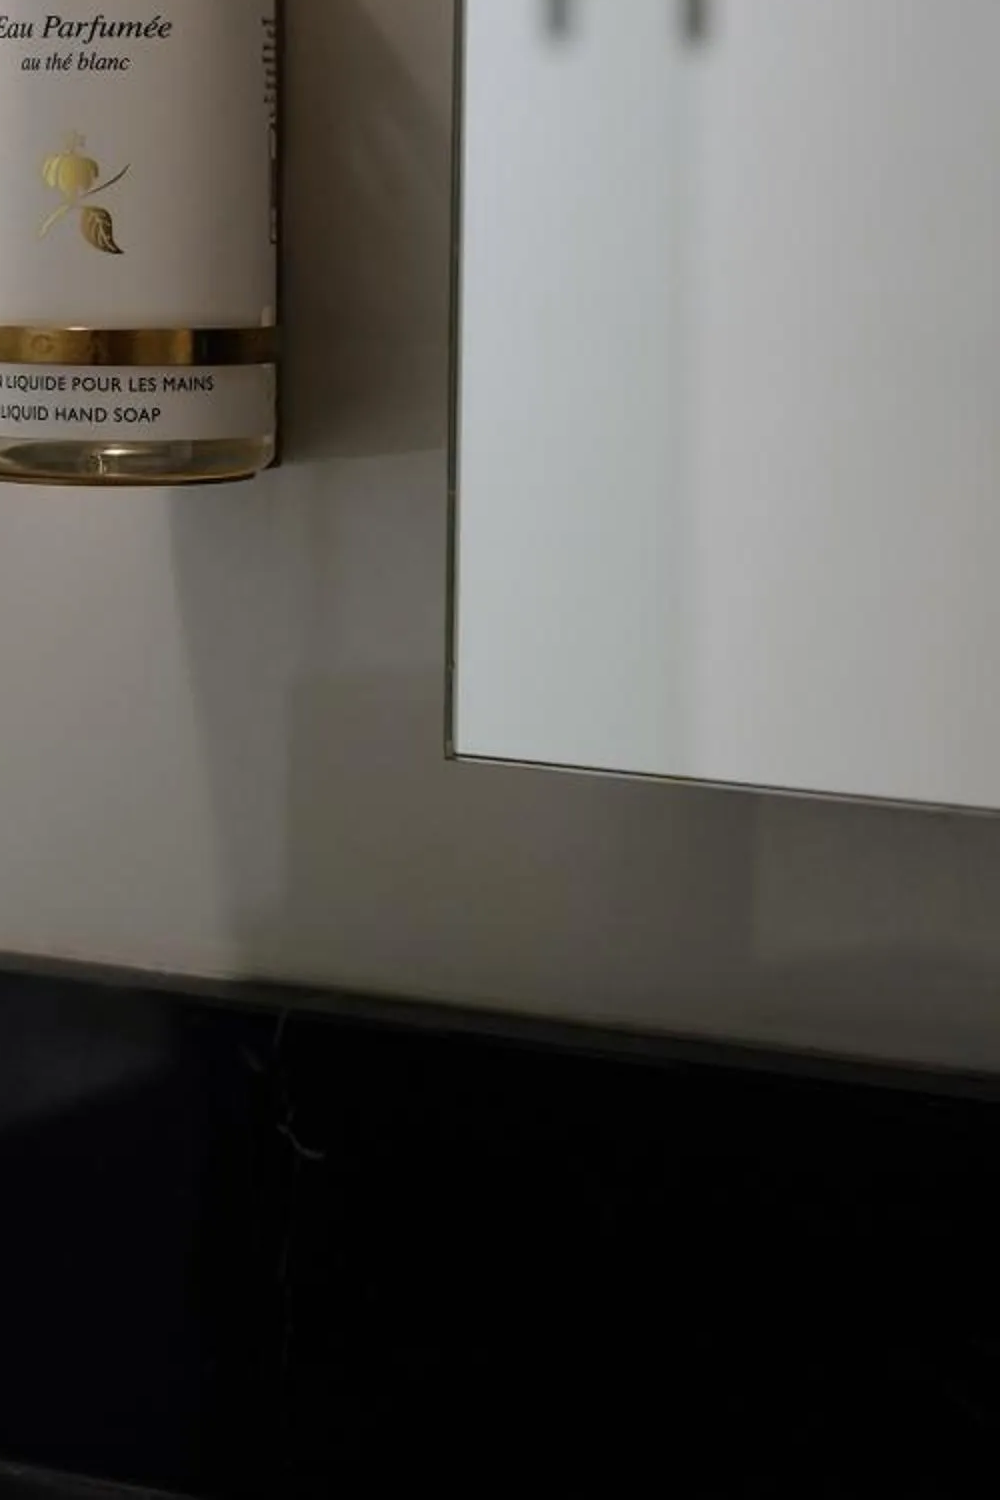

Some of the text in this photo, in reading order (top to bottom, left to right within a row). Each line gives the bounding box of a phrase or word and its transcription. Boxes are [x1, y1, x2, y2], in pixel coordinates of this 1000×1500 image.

[42, 14, 173, 45] Parfumée
[21, 52, 131, 71] au thé blanc
[6, 375, 66, 392] LIQUIDE
[72, 377, 122, 393] POUR
[128, 376, 157, 393] LES
[162, 375, 214, 393] MAINS
[1, 405, 161, 423] LIQUID HAND SOAP
